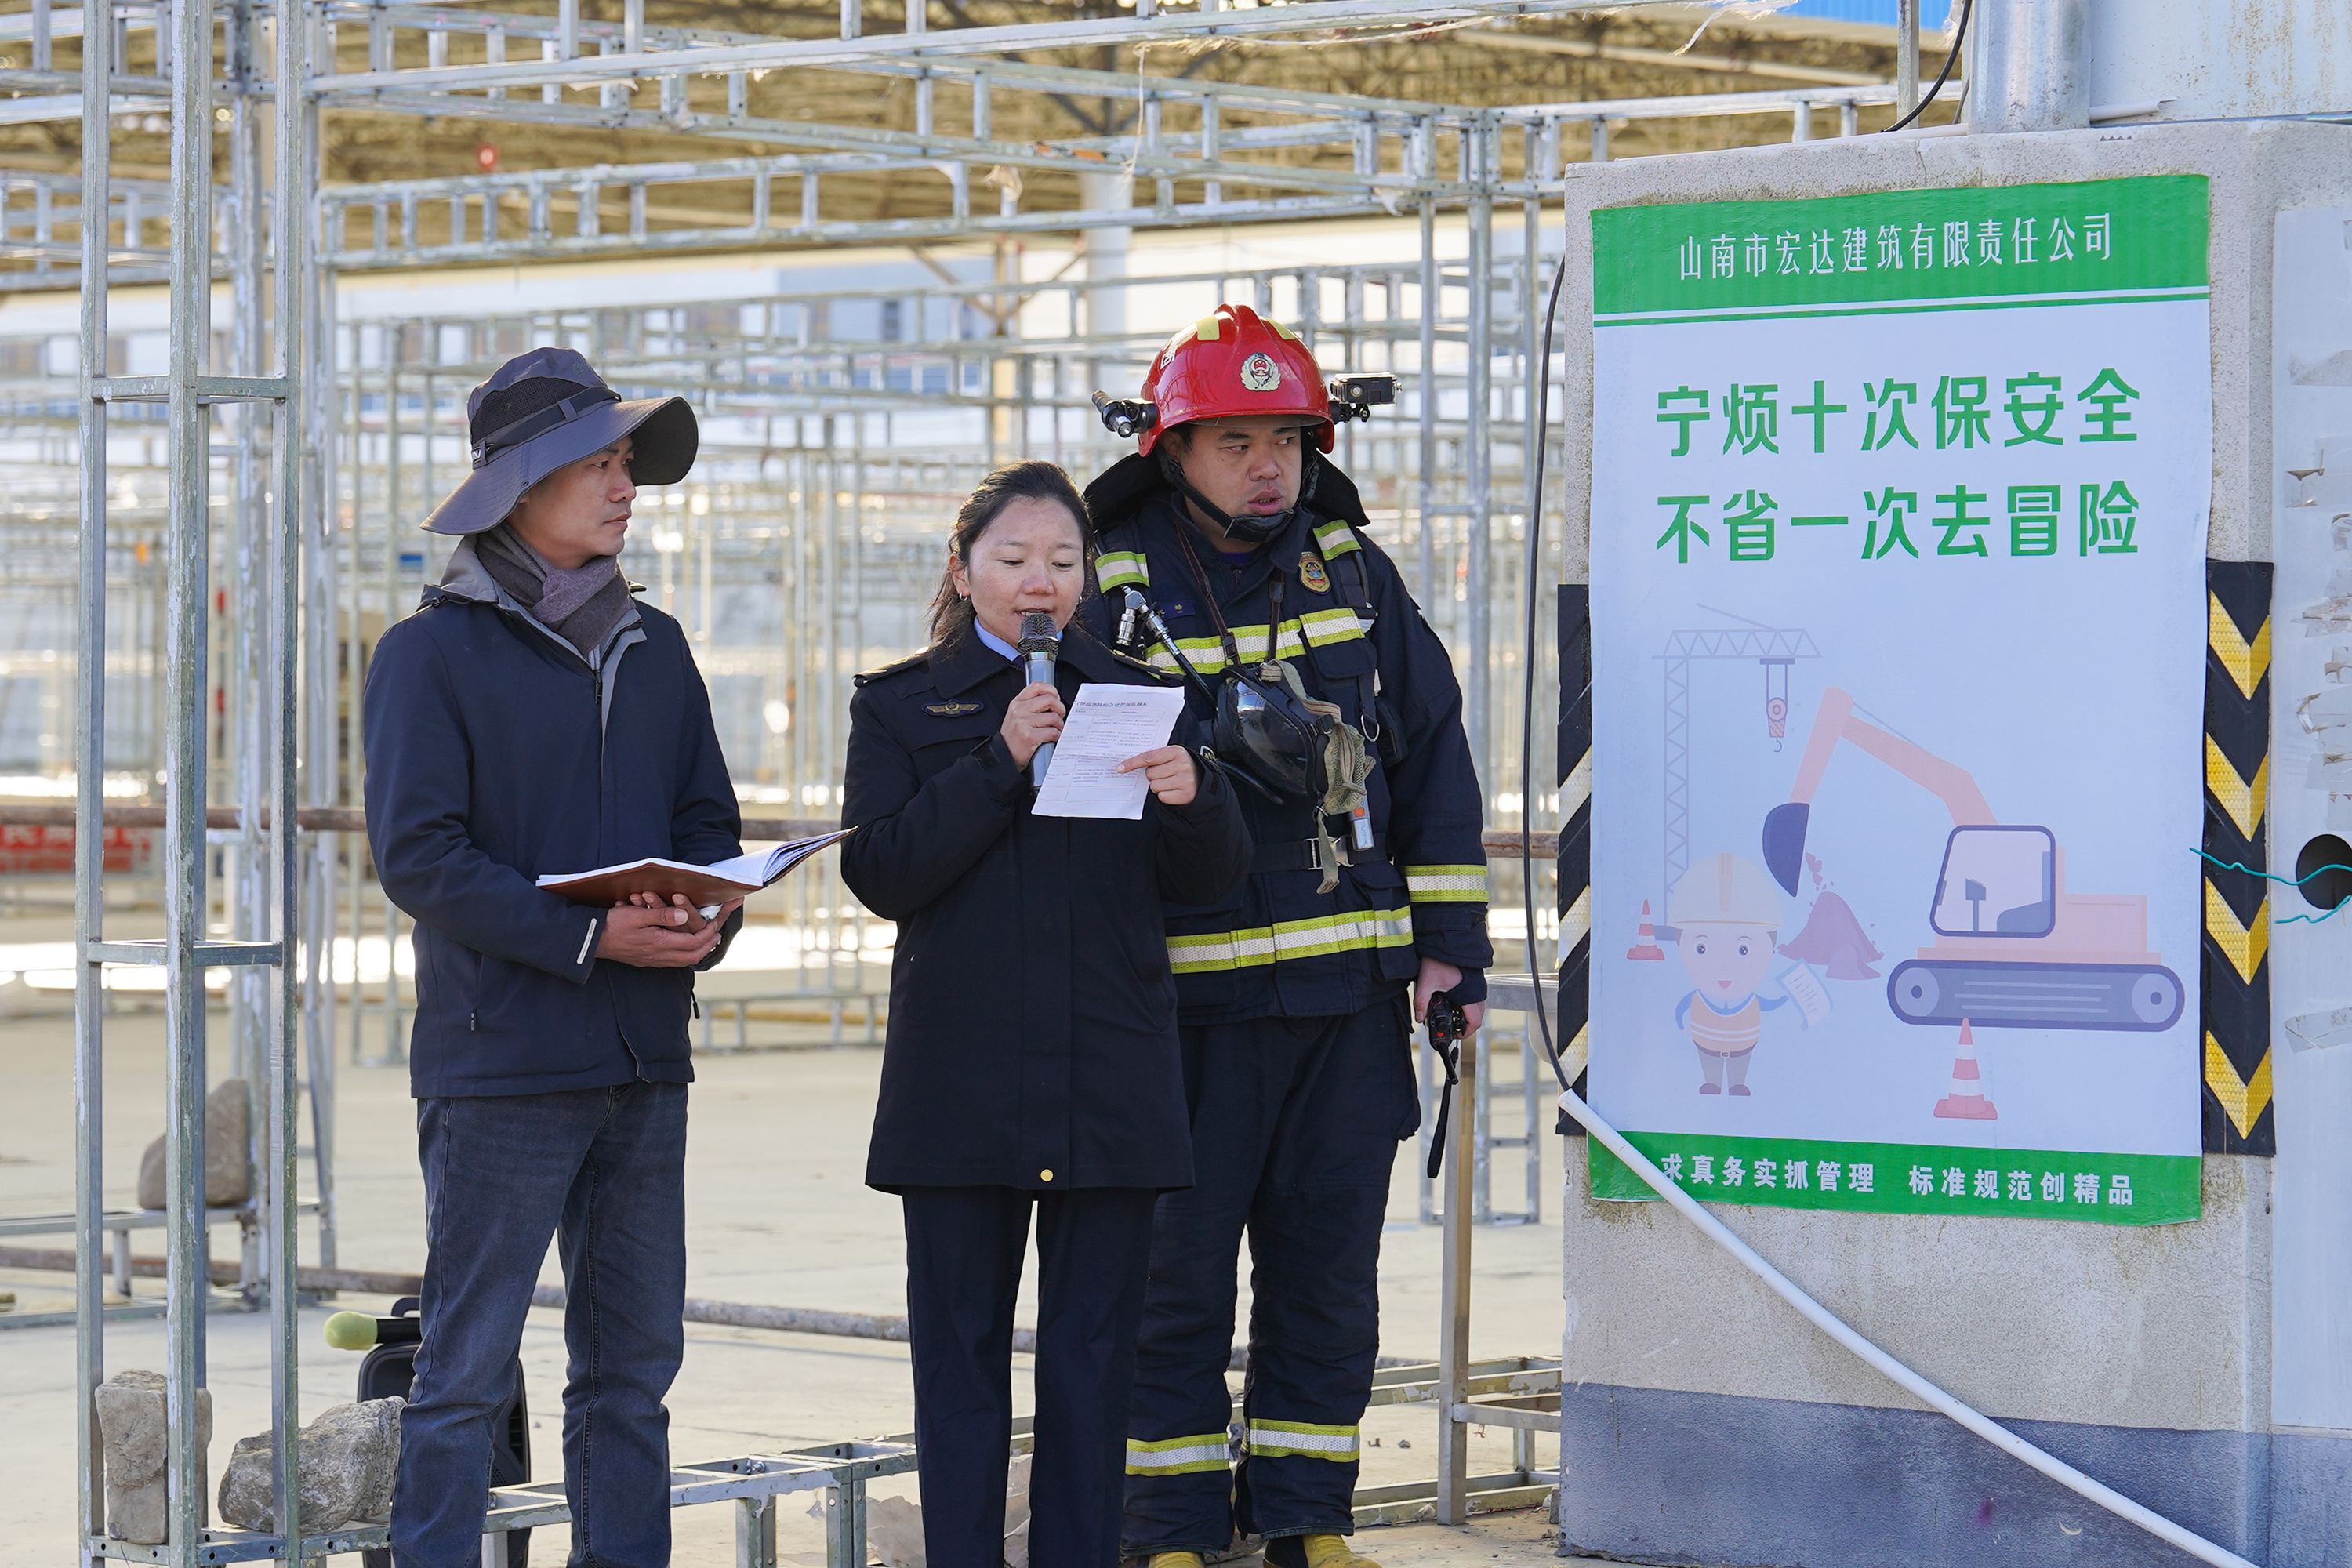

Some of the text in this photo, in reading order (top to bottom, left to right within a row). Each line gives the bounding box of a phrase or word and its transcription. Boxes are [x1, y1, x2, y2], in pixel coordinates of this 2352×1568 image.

[1679, 212, 2111, 281] 山南市宏达建筑有限责任公司
[1656, 368, 2140, 457] 宁烦十次保安全
[1656, 480, 2140, 564] 不省一次去冒险
[1661, 1153, 2133, 1205] 求真务实抓管理 标准规范创精品
